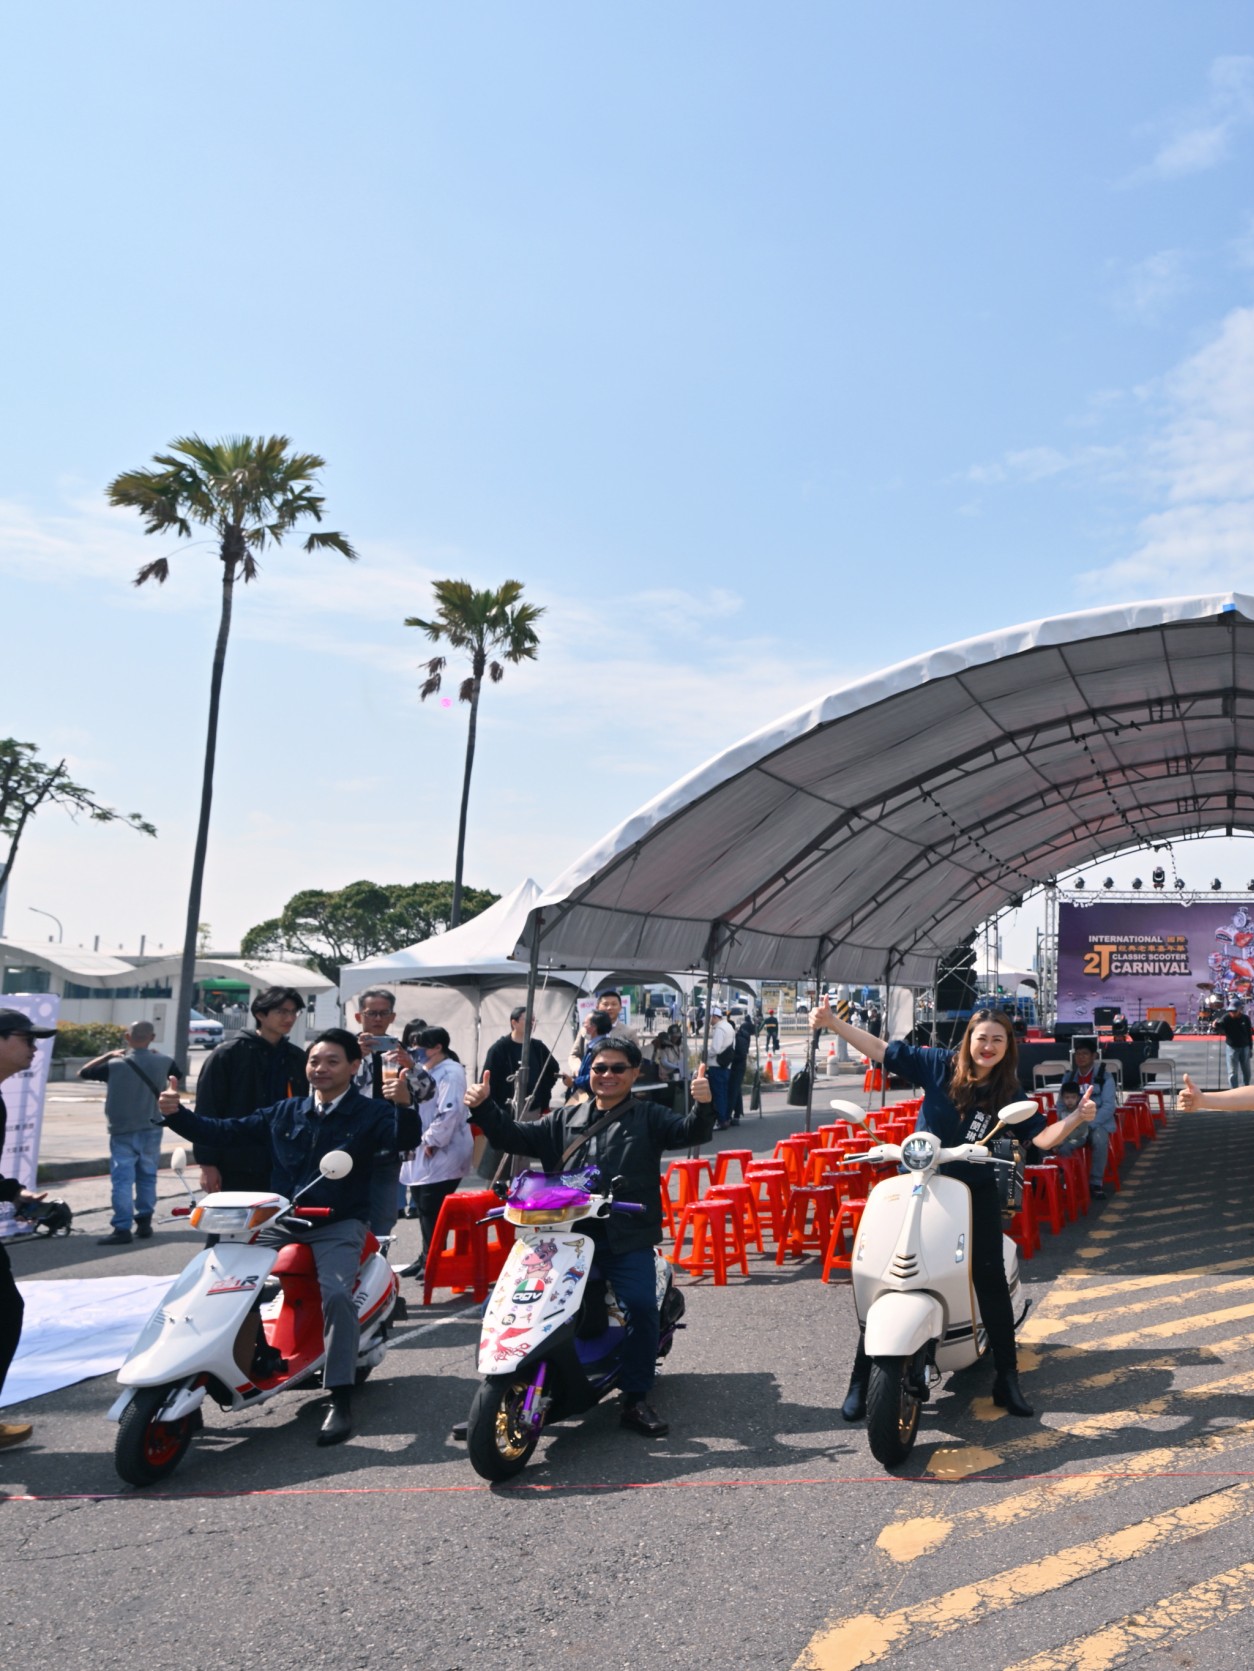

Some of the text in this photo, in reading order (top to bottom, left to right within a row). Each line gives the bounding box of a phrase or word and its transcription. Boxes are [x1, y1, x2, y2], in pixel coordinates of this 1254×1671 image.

[1088, 935, 1163, 943] INTERNATIONAL
[1083, 944, 1118, 980] 2T
[1111, 961, 1190, 973] CARNIVAL
[512, 1292, 543, 1301] agv
